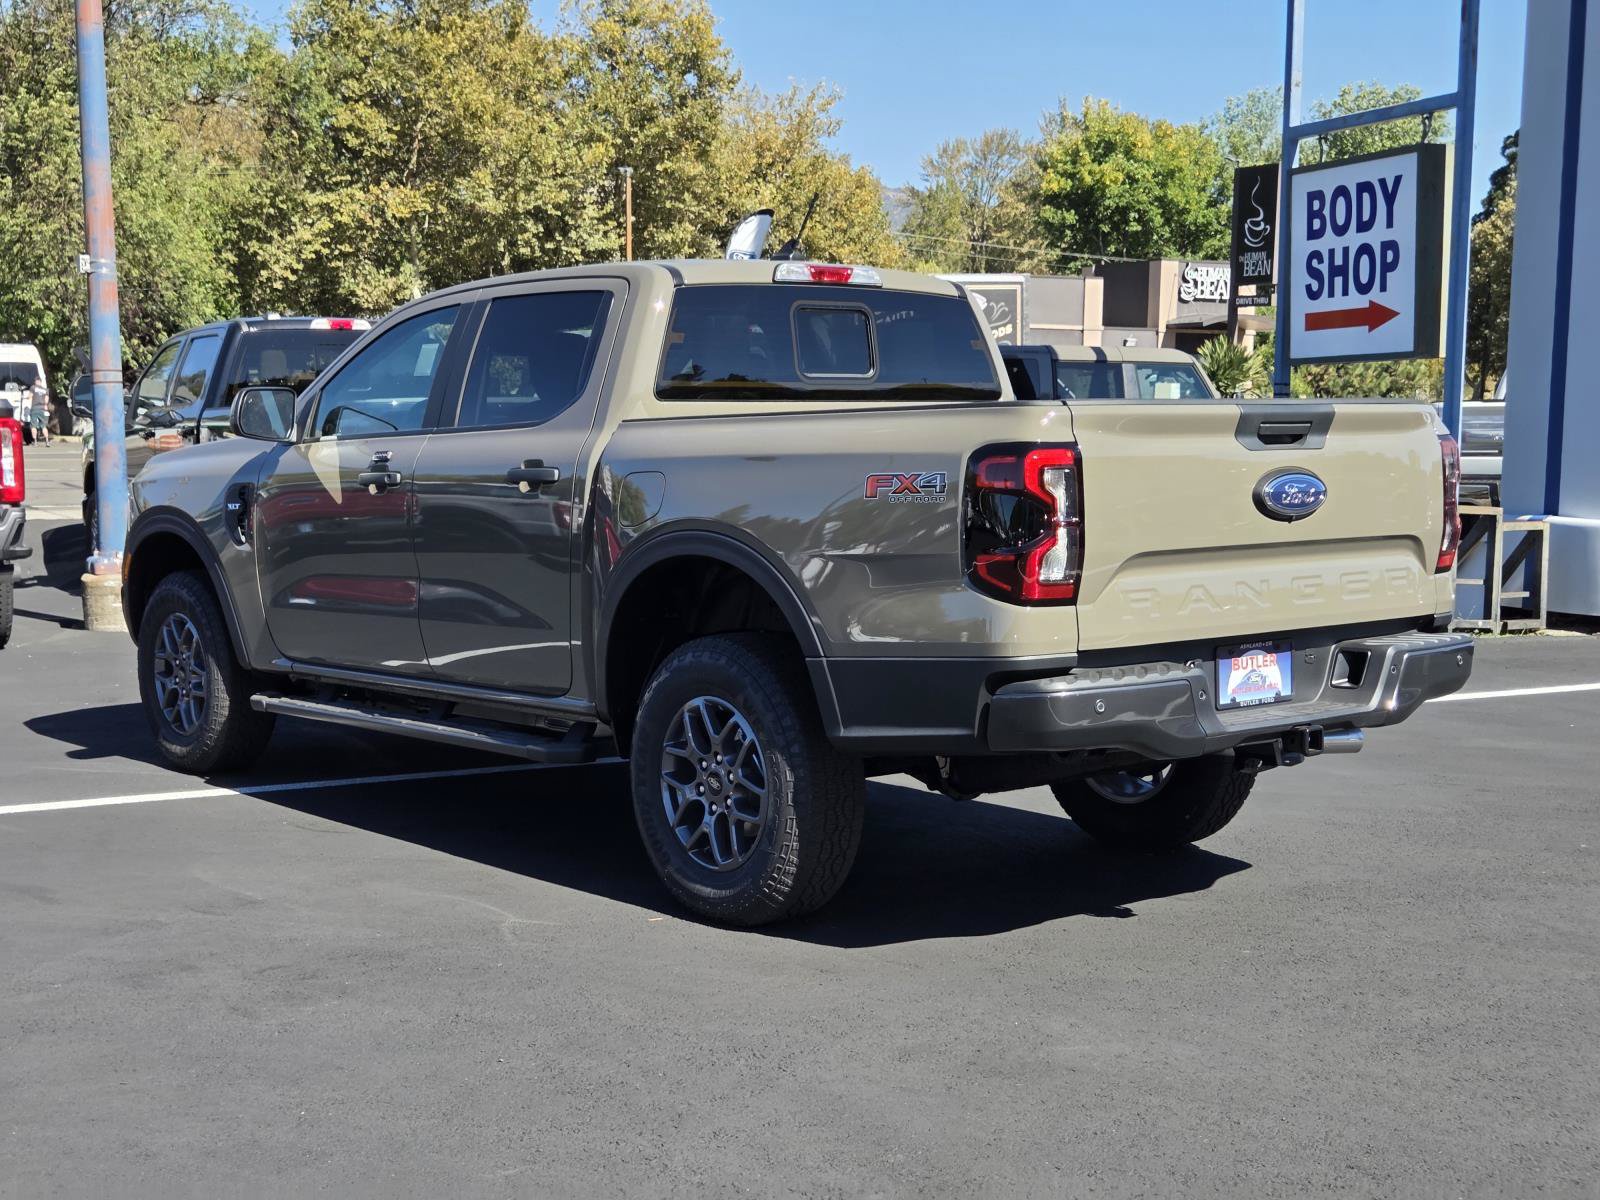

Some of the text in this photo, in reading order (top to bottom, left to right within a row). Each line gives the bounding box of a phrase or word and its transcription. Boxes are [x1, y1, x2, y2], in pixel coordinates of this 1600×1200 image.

[1306, 174, 1403, 241] BODY
[1244, 251, 1267, 262] HUMAN
[1243, 259, 1271, 277] BEAN
[1304, 239, 1400, 301] SHOP
[1235, 297, 1269, 305] DRIVE THRU
[863, 471, 948, 500] FX4
[888, 495, 947, 504] OFF ROAD
[1119, 565, 1422, 619] RANGER
[1231, 653, 1277, 672] BUTLER
[1240, 696, 1275, 707] BUTLER FORD
